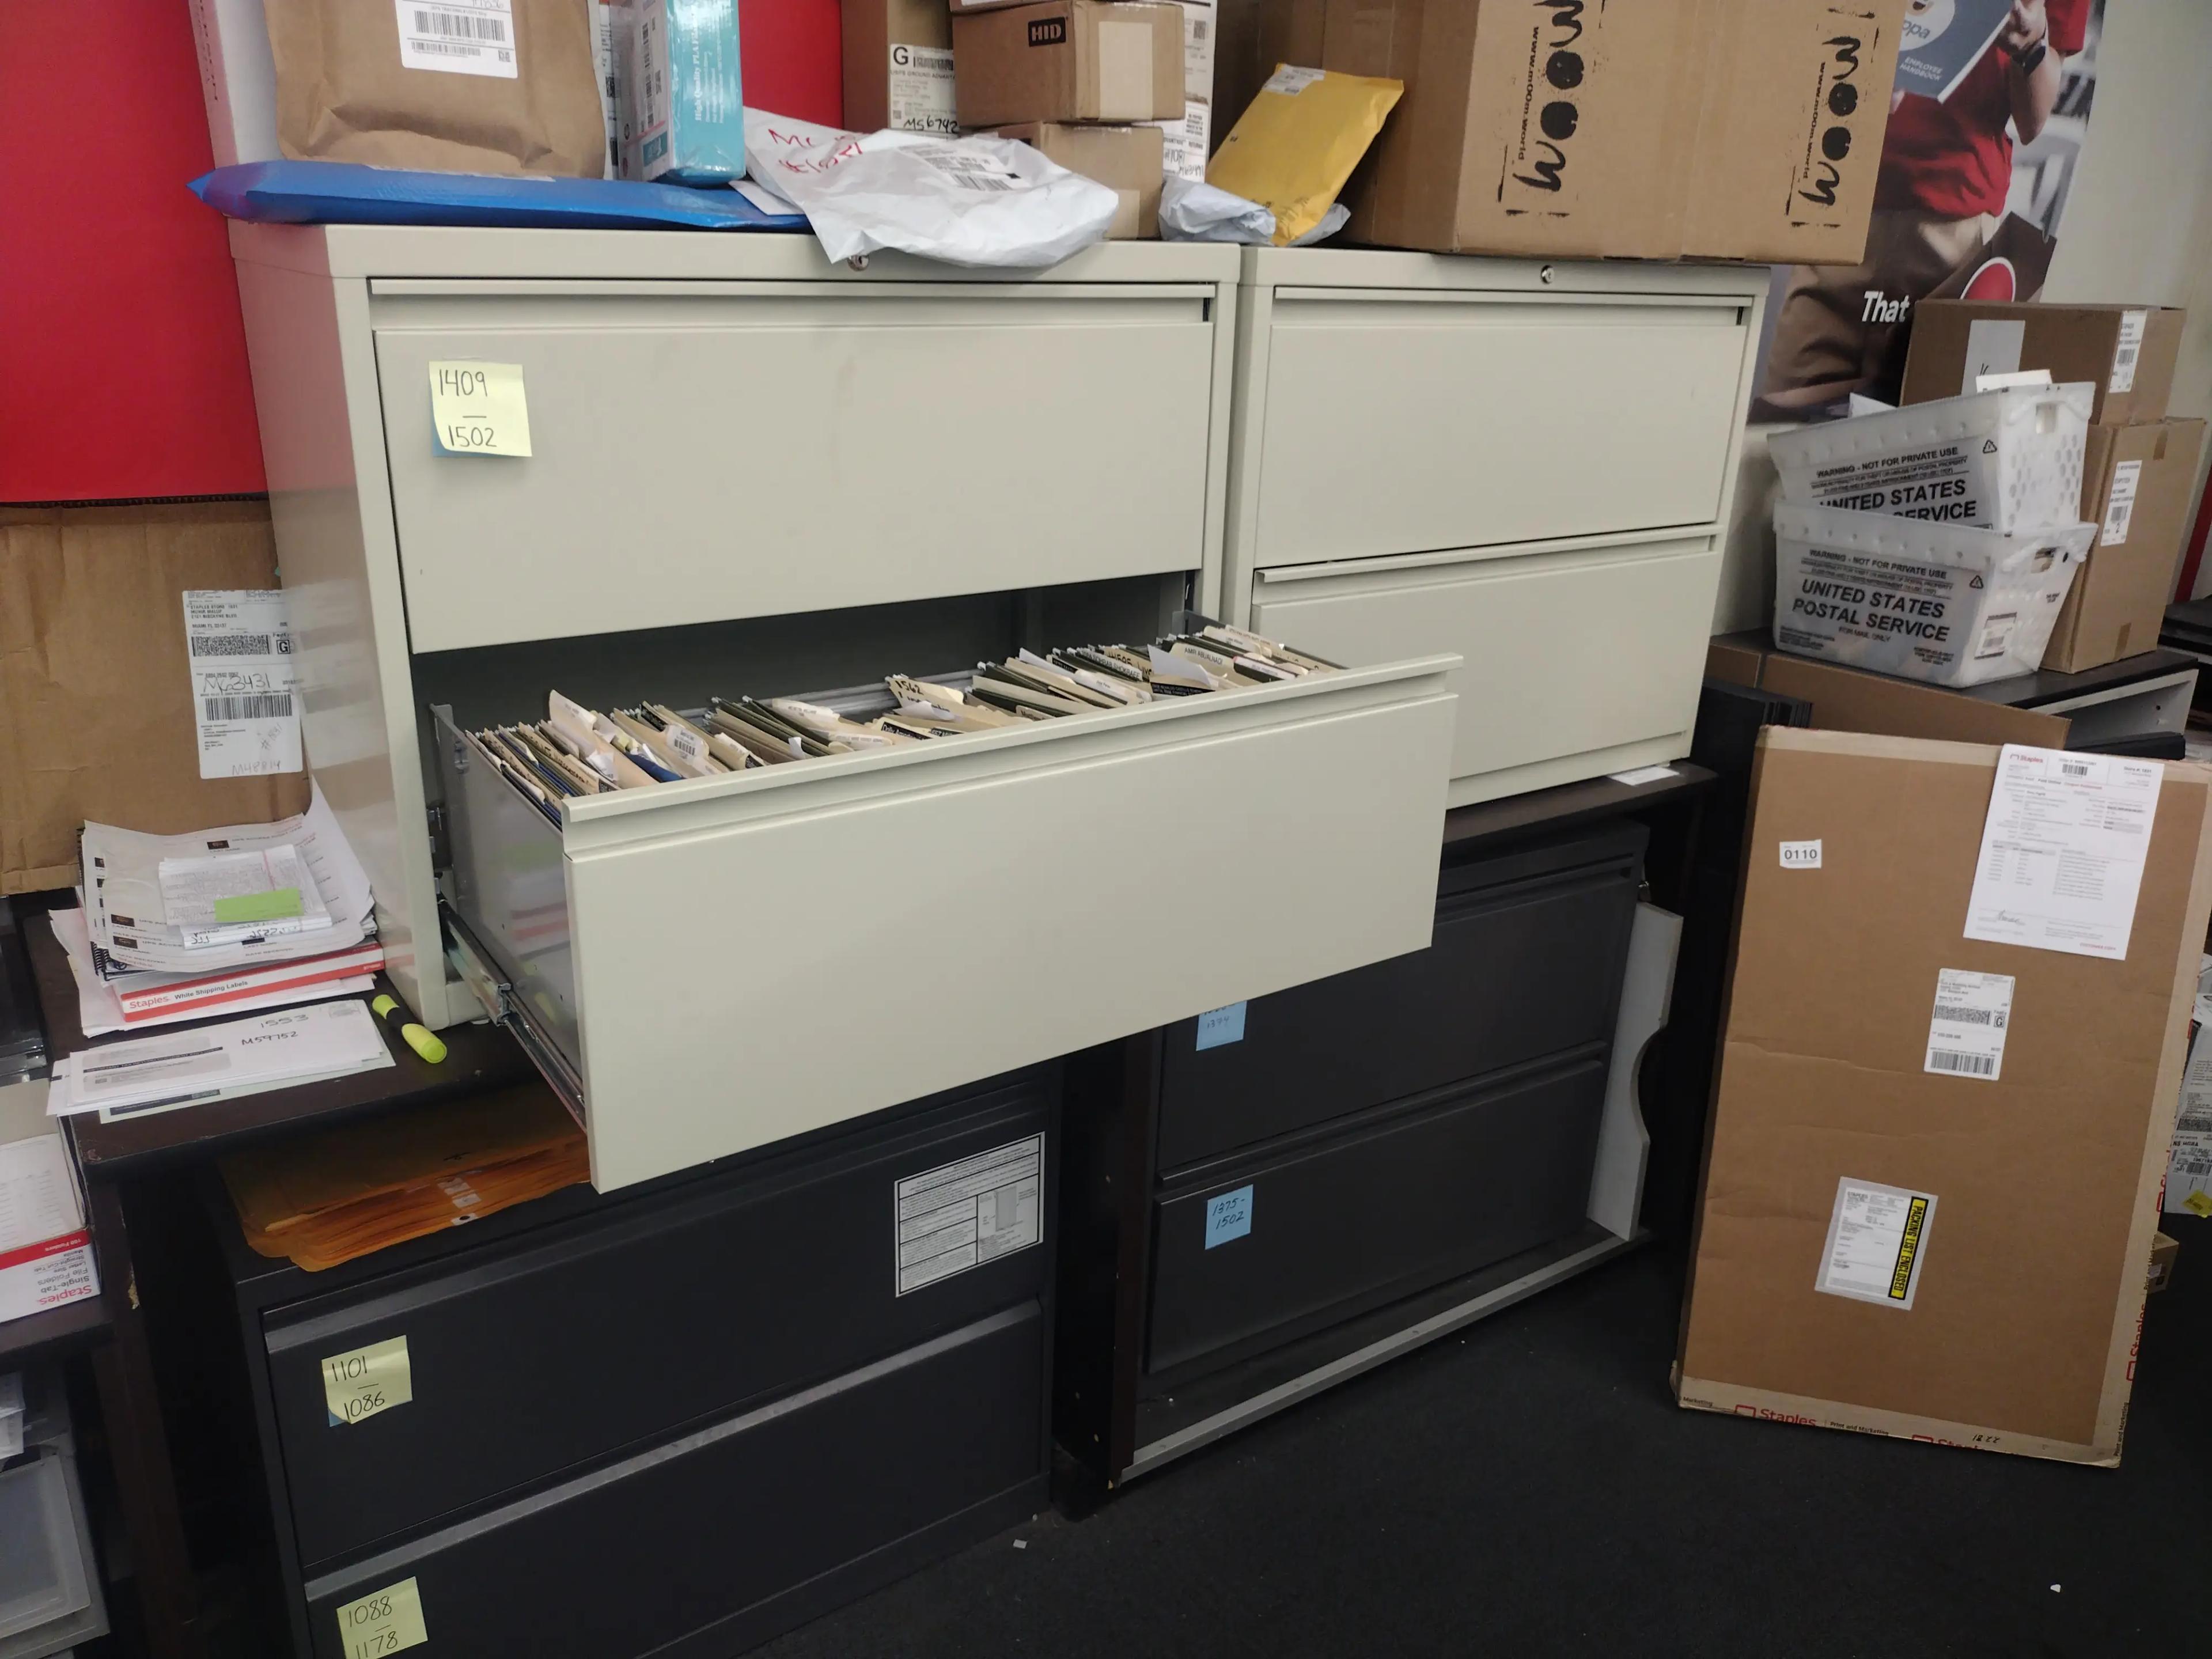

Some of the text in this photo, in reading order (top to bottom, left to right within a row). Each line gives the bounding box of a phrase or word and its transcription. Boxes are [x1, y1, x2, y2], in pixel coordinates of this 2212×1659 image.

[1031, 25, 1062, 40] HID
[893, 47, 908, 65] G
[1904, 56, 1943, 73] EMPLOYEE
[1899, 63, 1942, 81] HANDBOOK
[1861, 290, 1910, 323] That
[439, 369, 487, 396] 1409
[448, 425, 497, 447] 1502
[1817, 465, 1855, 478] WARNING
[1862, 460, 1879, 470] NOT
[1881, 457, 1899, 467] FOR
[1902, 451, 1937, 464] PRIVATE
[1940, 446, 1958, 456] USE
[1891, 479, 1965, 506] STATES
[1809, 549, 1846, 562] WARNING
[1853, 556, 1870, 566] NOT
[1872, 559, 1889, 569] FOR
[1891, 563, 1927, 577] PRIVATE
[1929, 569, 1947, 579] USE
[1802, 578, 1945, 618] UNITED STATES
[1793, 598, 1860, 625] POSTAL
[1866, 613, 1950, 642] SERVICE
[895, 680, 925, 695] 1562
[2019, 755, 2043, 764] Staples
[1784, 849, 1817, 859] 0110
[130, 980, 248, 1009] Staples White Shipping Labels
[261, 1014, 309, 1028] 1553
[1996, 1017, 2003, 1027] G
[241, 1031, 298, 1045] M59752
[1215, 1211, 1245, 1229] 1502
[1893, 1205, 1922, 1291] PACKING LIST ENCLOSED
[37, 1268, 88, 1286] File Folders
[41, 1275, 90, 1293] Single-Tab
[40, 1285, 92, 1305] Staples
[332, 1355, 368, 1382] 1101
[344, 1391, 385, 1421] 1086
[1760, 1408, 1816, 1427] Staples
[1830, 1421, 1844, 1429] Print
[349, 1596, 392, 1627] 1088
[356, 1631, 398, 1659] 1178
